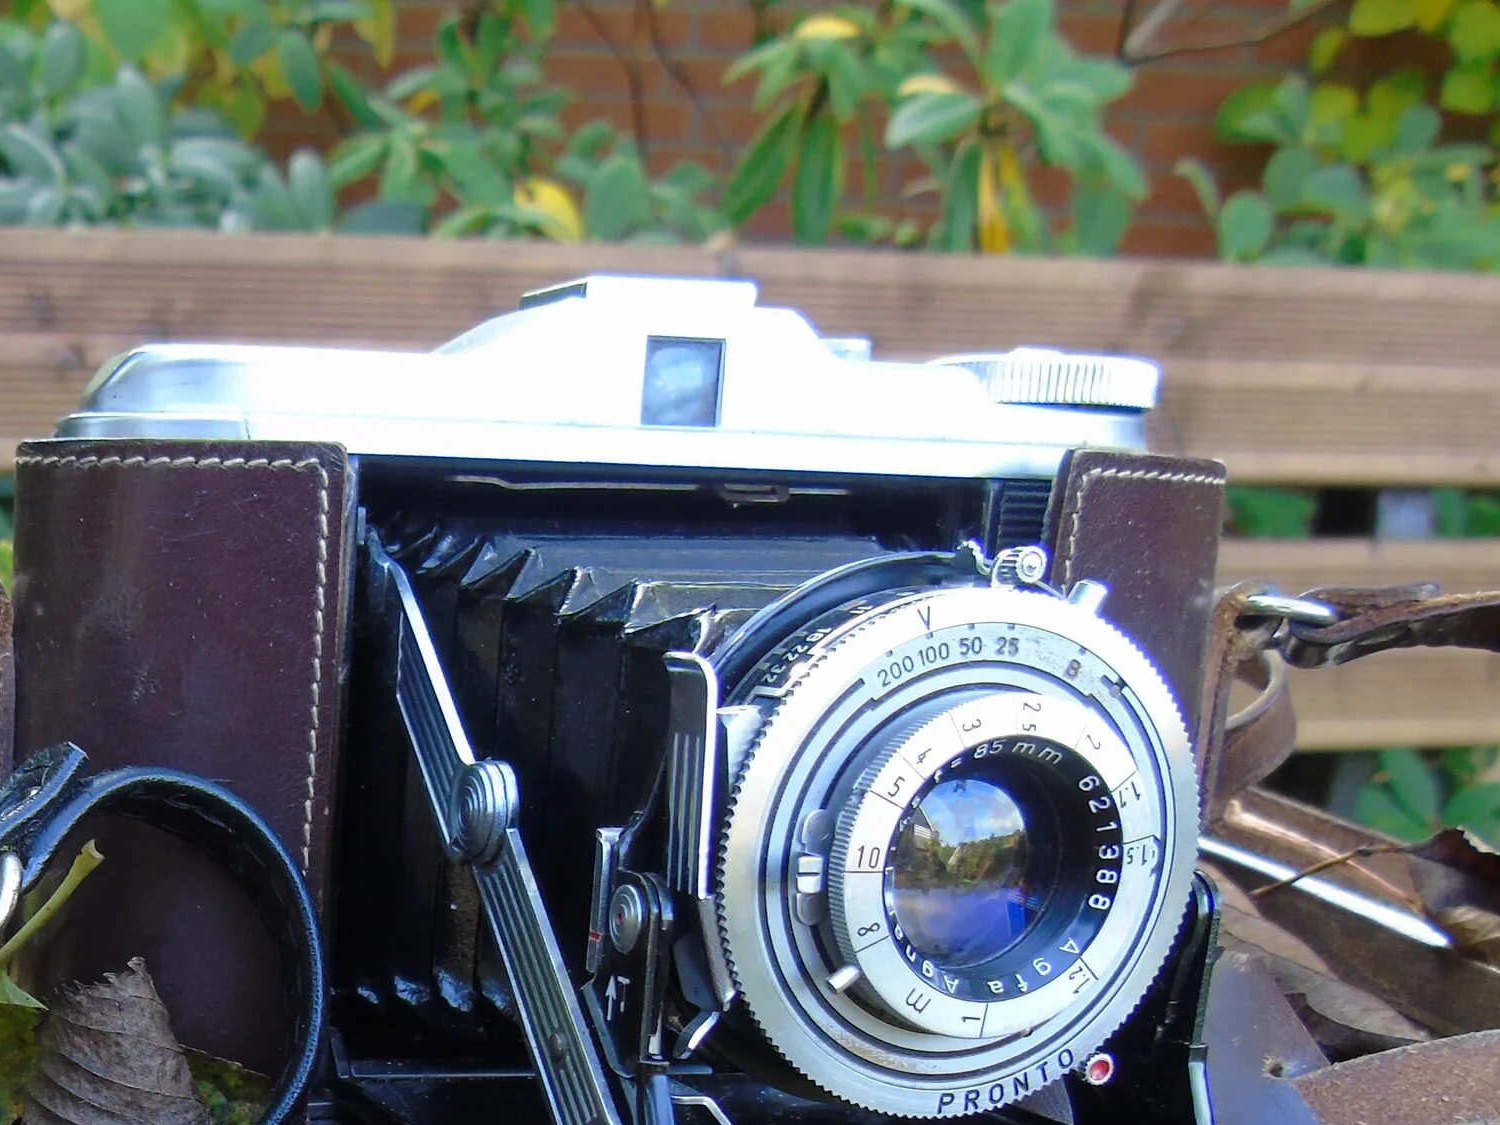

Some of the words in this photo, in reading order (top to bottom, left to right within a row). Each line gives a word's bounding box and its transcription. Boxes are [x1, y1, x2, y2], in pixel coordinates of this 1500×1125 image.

[782, 644, 809, 663] 22
[919, 642, 949, 666] 100
[958, 636, 983, 656] 50
[998, 636, 1019, 656] 25
[761, 664, 786, 685] 32
[877, 655, 915, 687] 200
[962, 718, 982, 733] 3
[916, 748, 932, 765] 4
[973, 739, 1005, 760] 85
[1012, 741, 1063, 765] mm
[887, 776, 905, 798] 5
[1078, 775, 1120, 911] 621388
[856, 845, 880, 869] 10
[987, 937, 1080, 994] Agfa
[937, 1048, 1075, 1115] PRONTO
